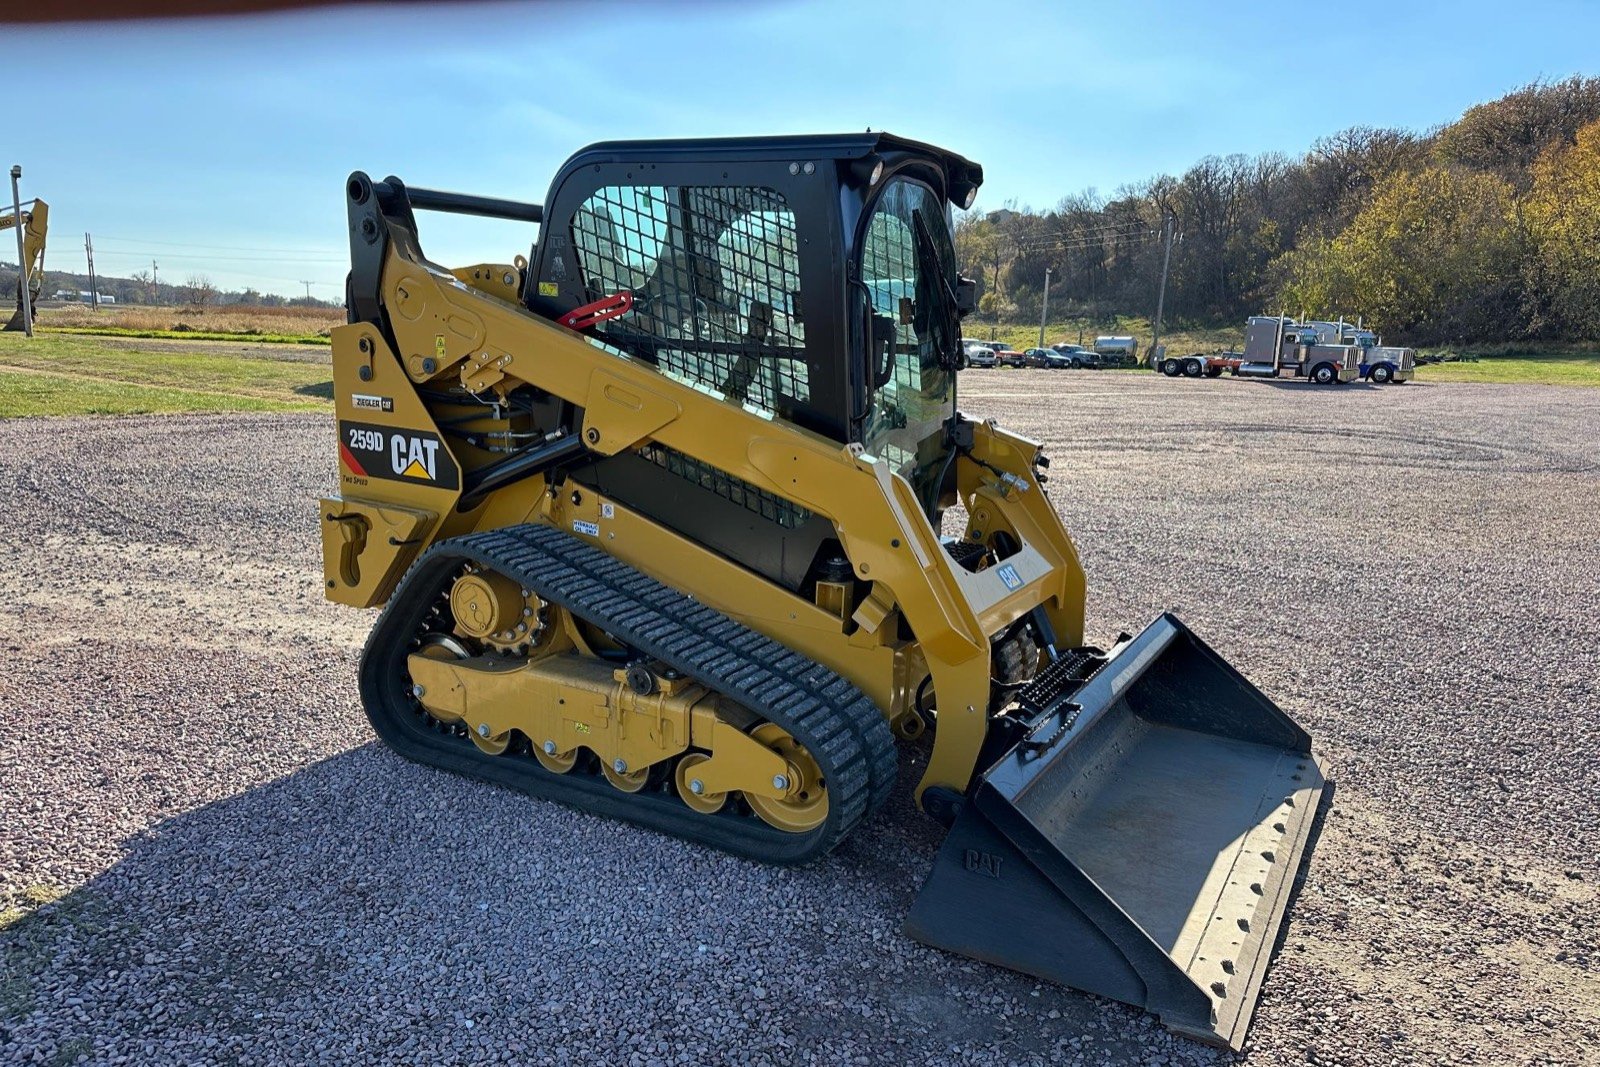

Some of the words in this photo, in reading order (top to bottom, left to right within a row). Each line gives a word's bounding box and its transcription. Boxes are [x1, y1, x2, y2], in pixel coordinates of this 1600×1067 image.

[356, 398, 380, 408] ZIEGLER
[382, 400, 391, 409] CAT
[349, 428, 384, 452] 259D
[390, 434, 439, 480] CAT
[999, 565, 1021, 589] CAT
[964, 849, 1003, 878] CAT
